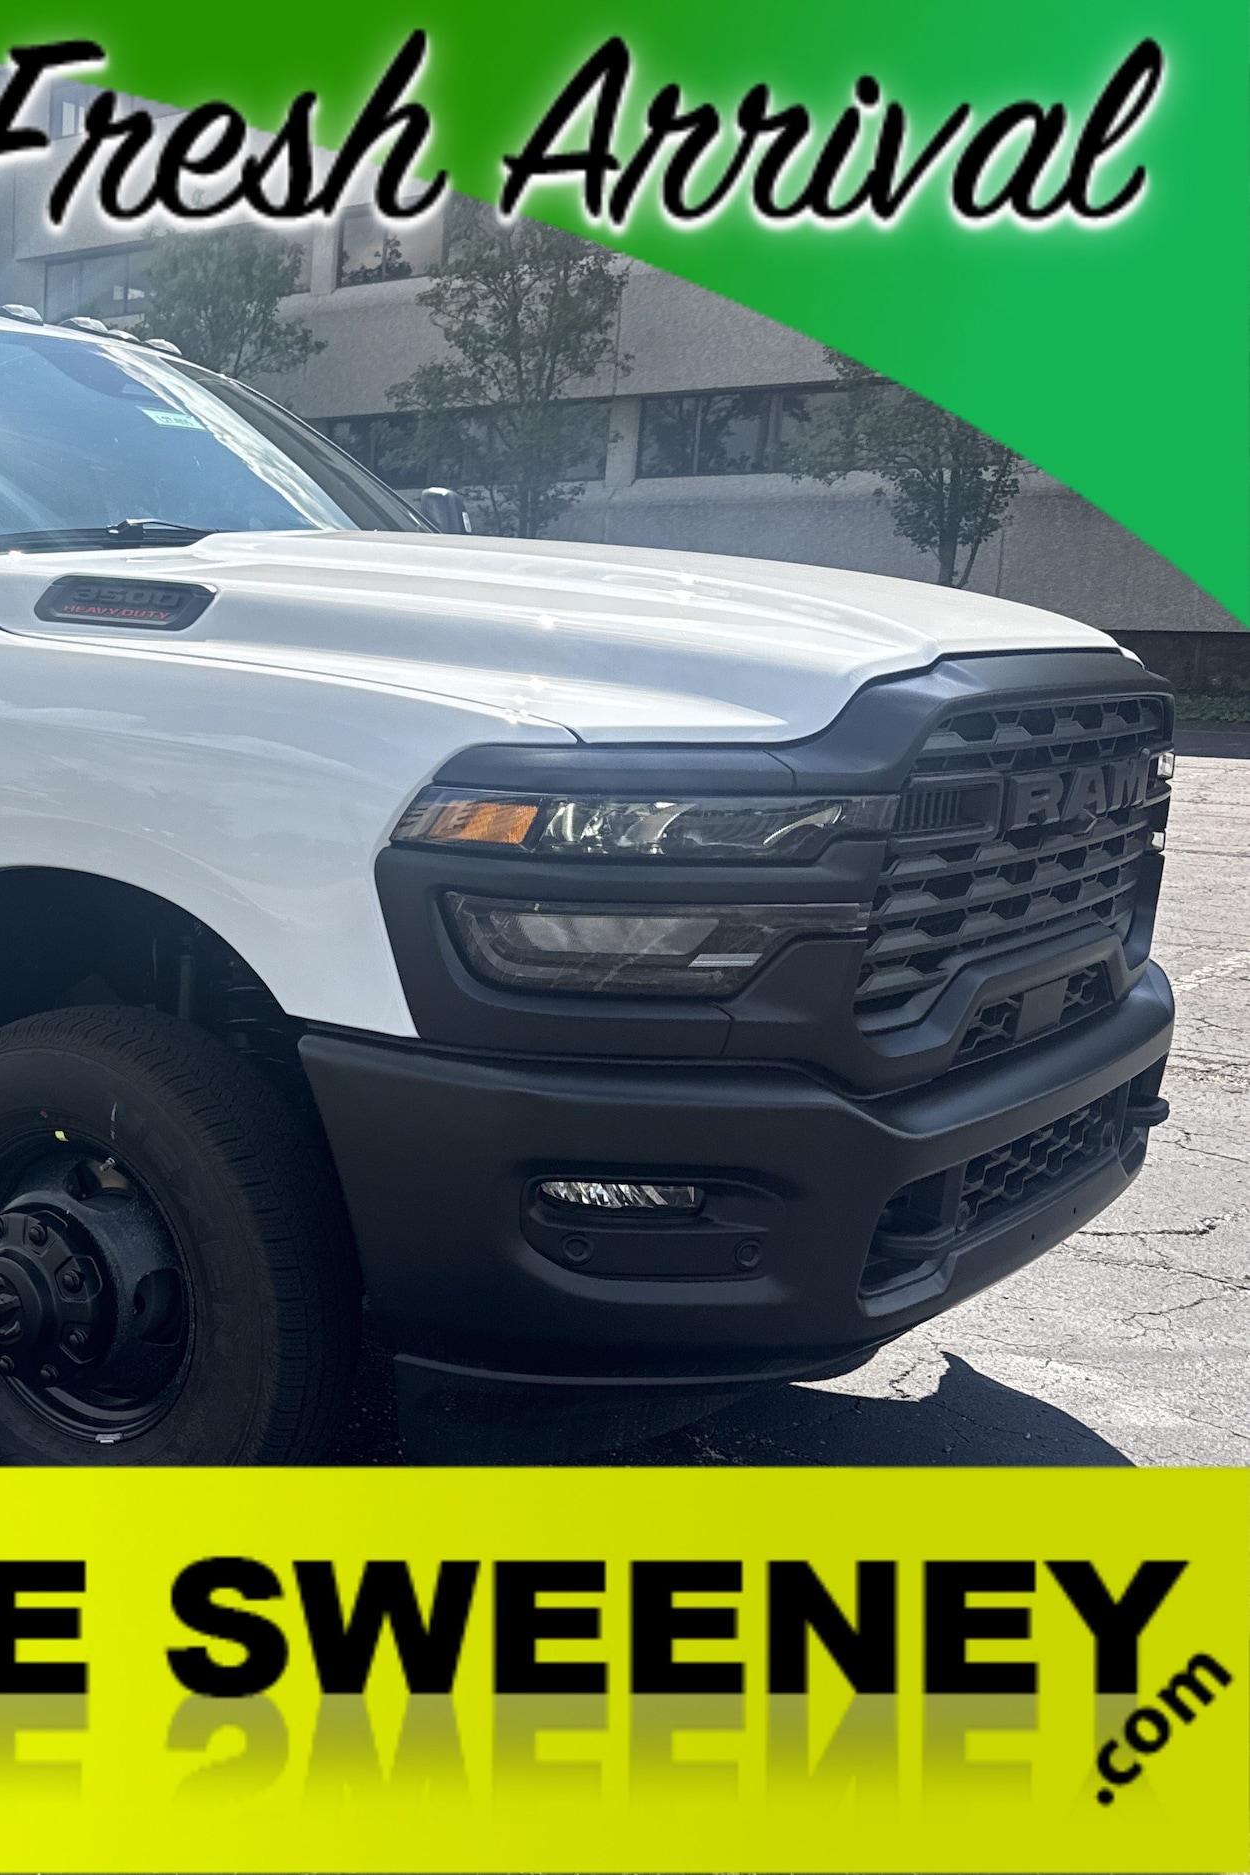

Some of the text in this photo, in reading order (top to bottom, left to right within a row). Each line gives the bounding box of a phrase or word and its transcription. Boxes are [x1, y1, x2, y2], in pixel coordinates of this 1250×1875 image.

[71, 586, 181, 608] 3500
[62, 604, 171, 620] HEAVY DUTY
[1004, 758, 1150, 831] RAM
